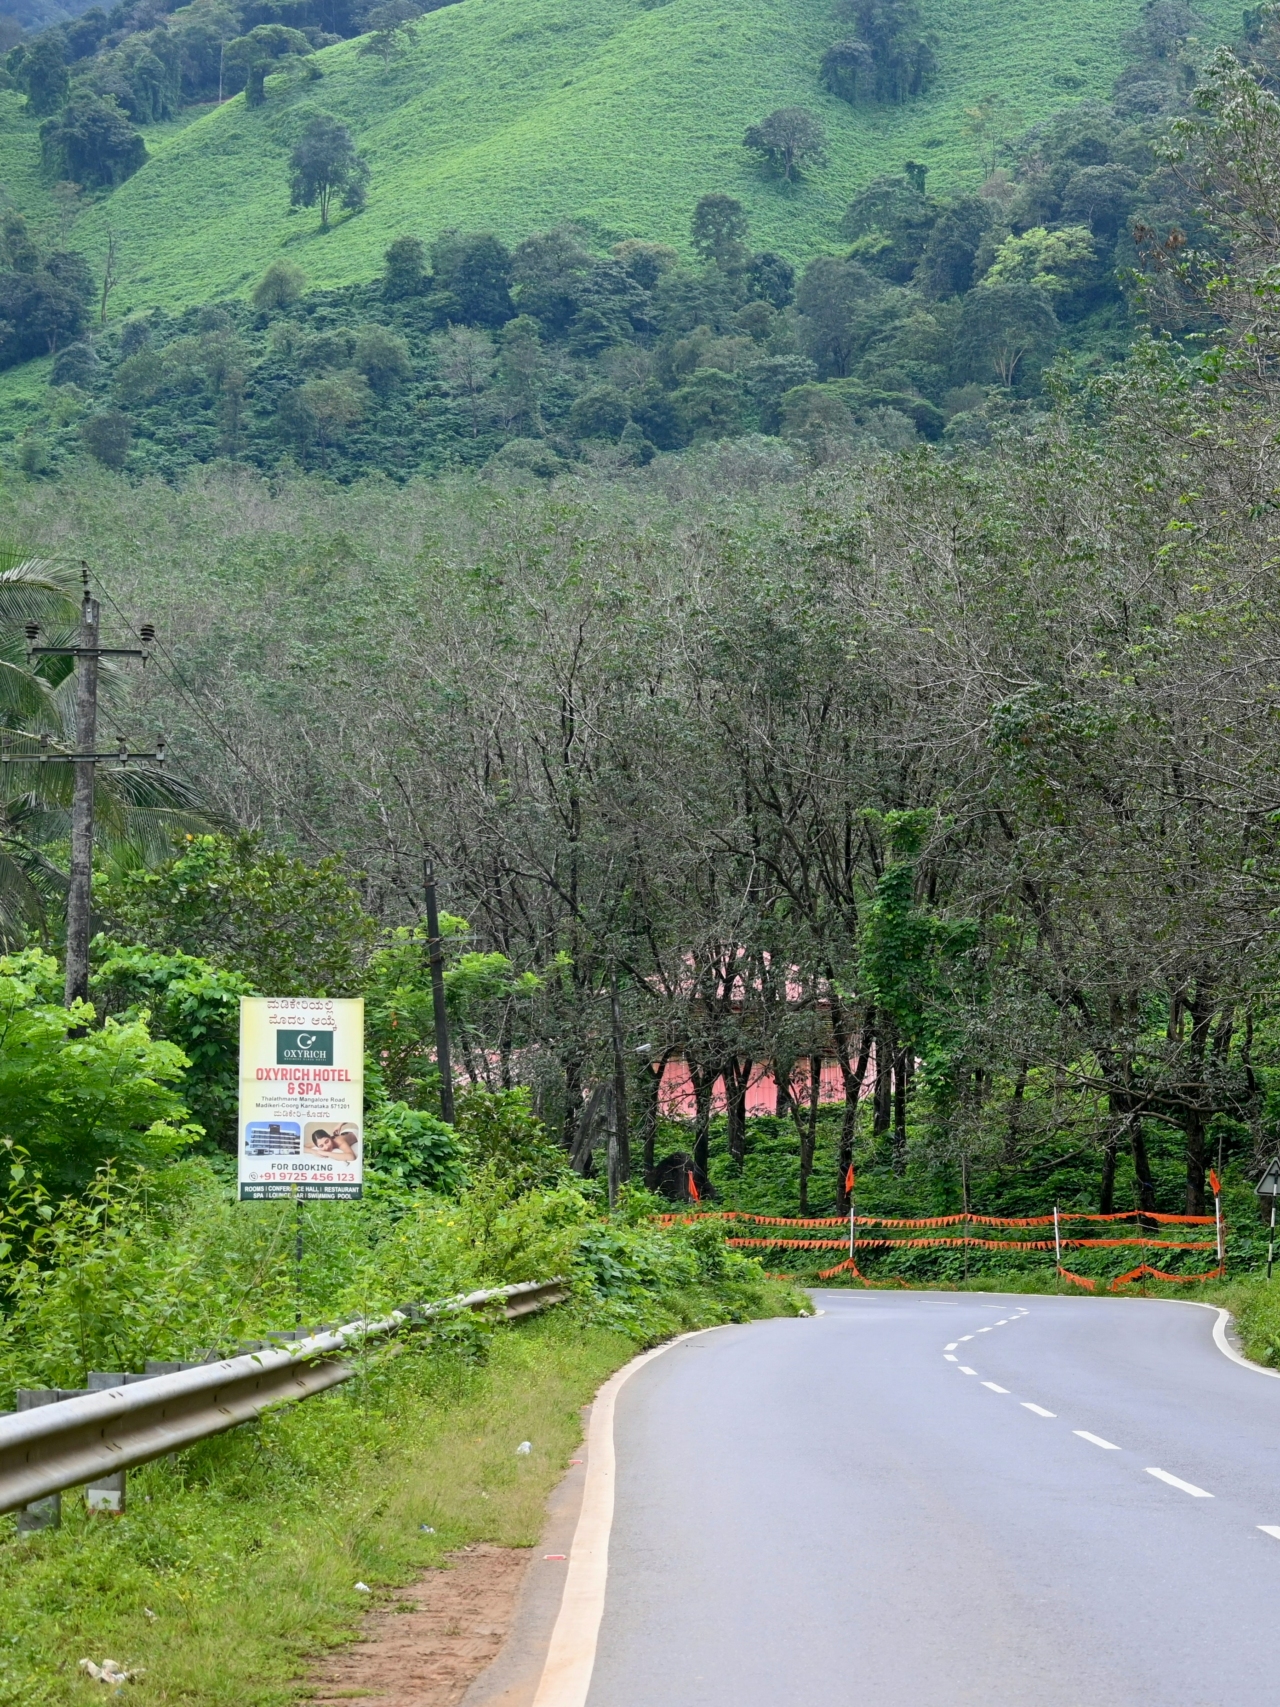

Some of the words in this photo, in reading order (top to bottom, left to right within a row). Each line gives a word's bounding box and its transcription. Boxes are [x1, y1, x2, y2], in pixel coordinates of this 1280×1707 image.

[284, 1049, 326, 1058] OXYRICH
[256, 1068, 310, 1081] OXYRICH
[313, 1069, 351, 1081] HOTEL
[287, 1082, 295, 1095] &
[298, 1082, 322, 1095] SPA
[292, 1163, 333, 1171] BOOKING
[259, 1172, 276, 1180] +91
[279, 1172, 307, 1181] 9725
[311, 1173, 333, 1181] 456
[337, 1173, 355, 1181] 123
